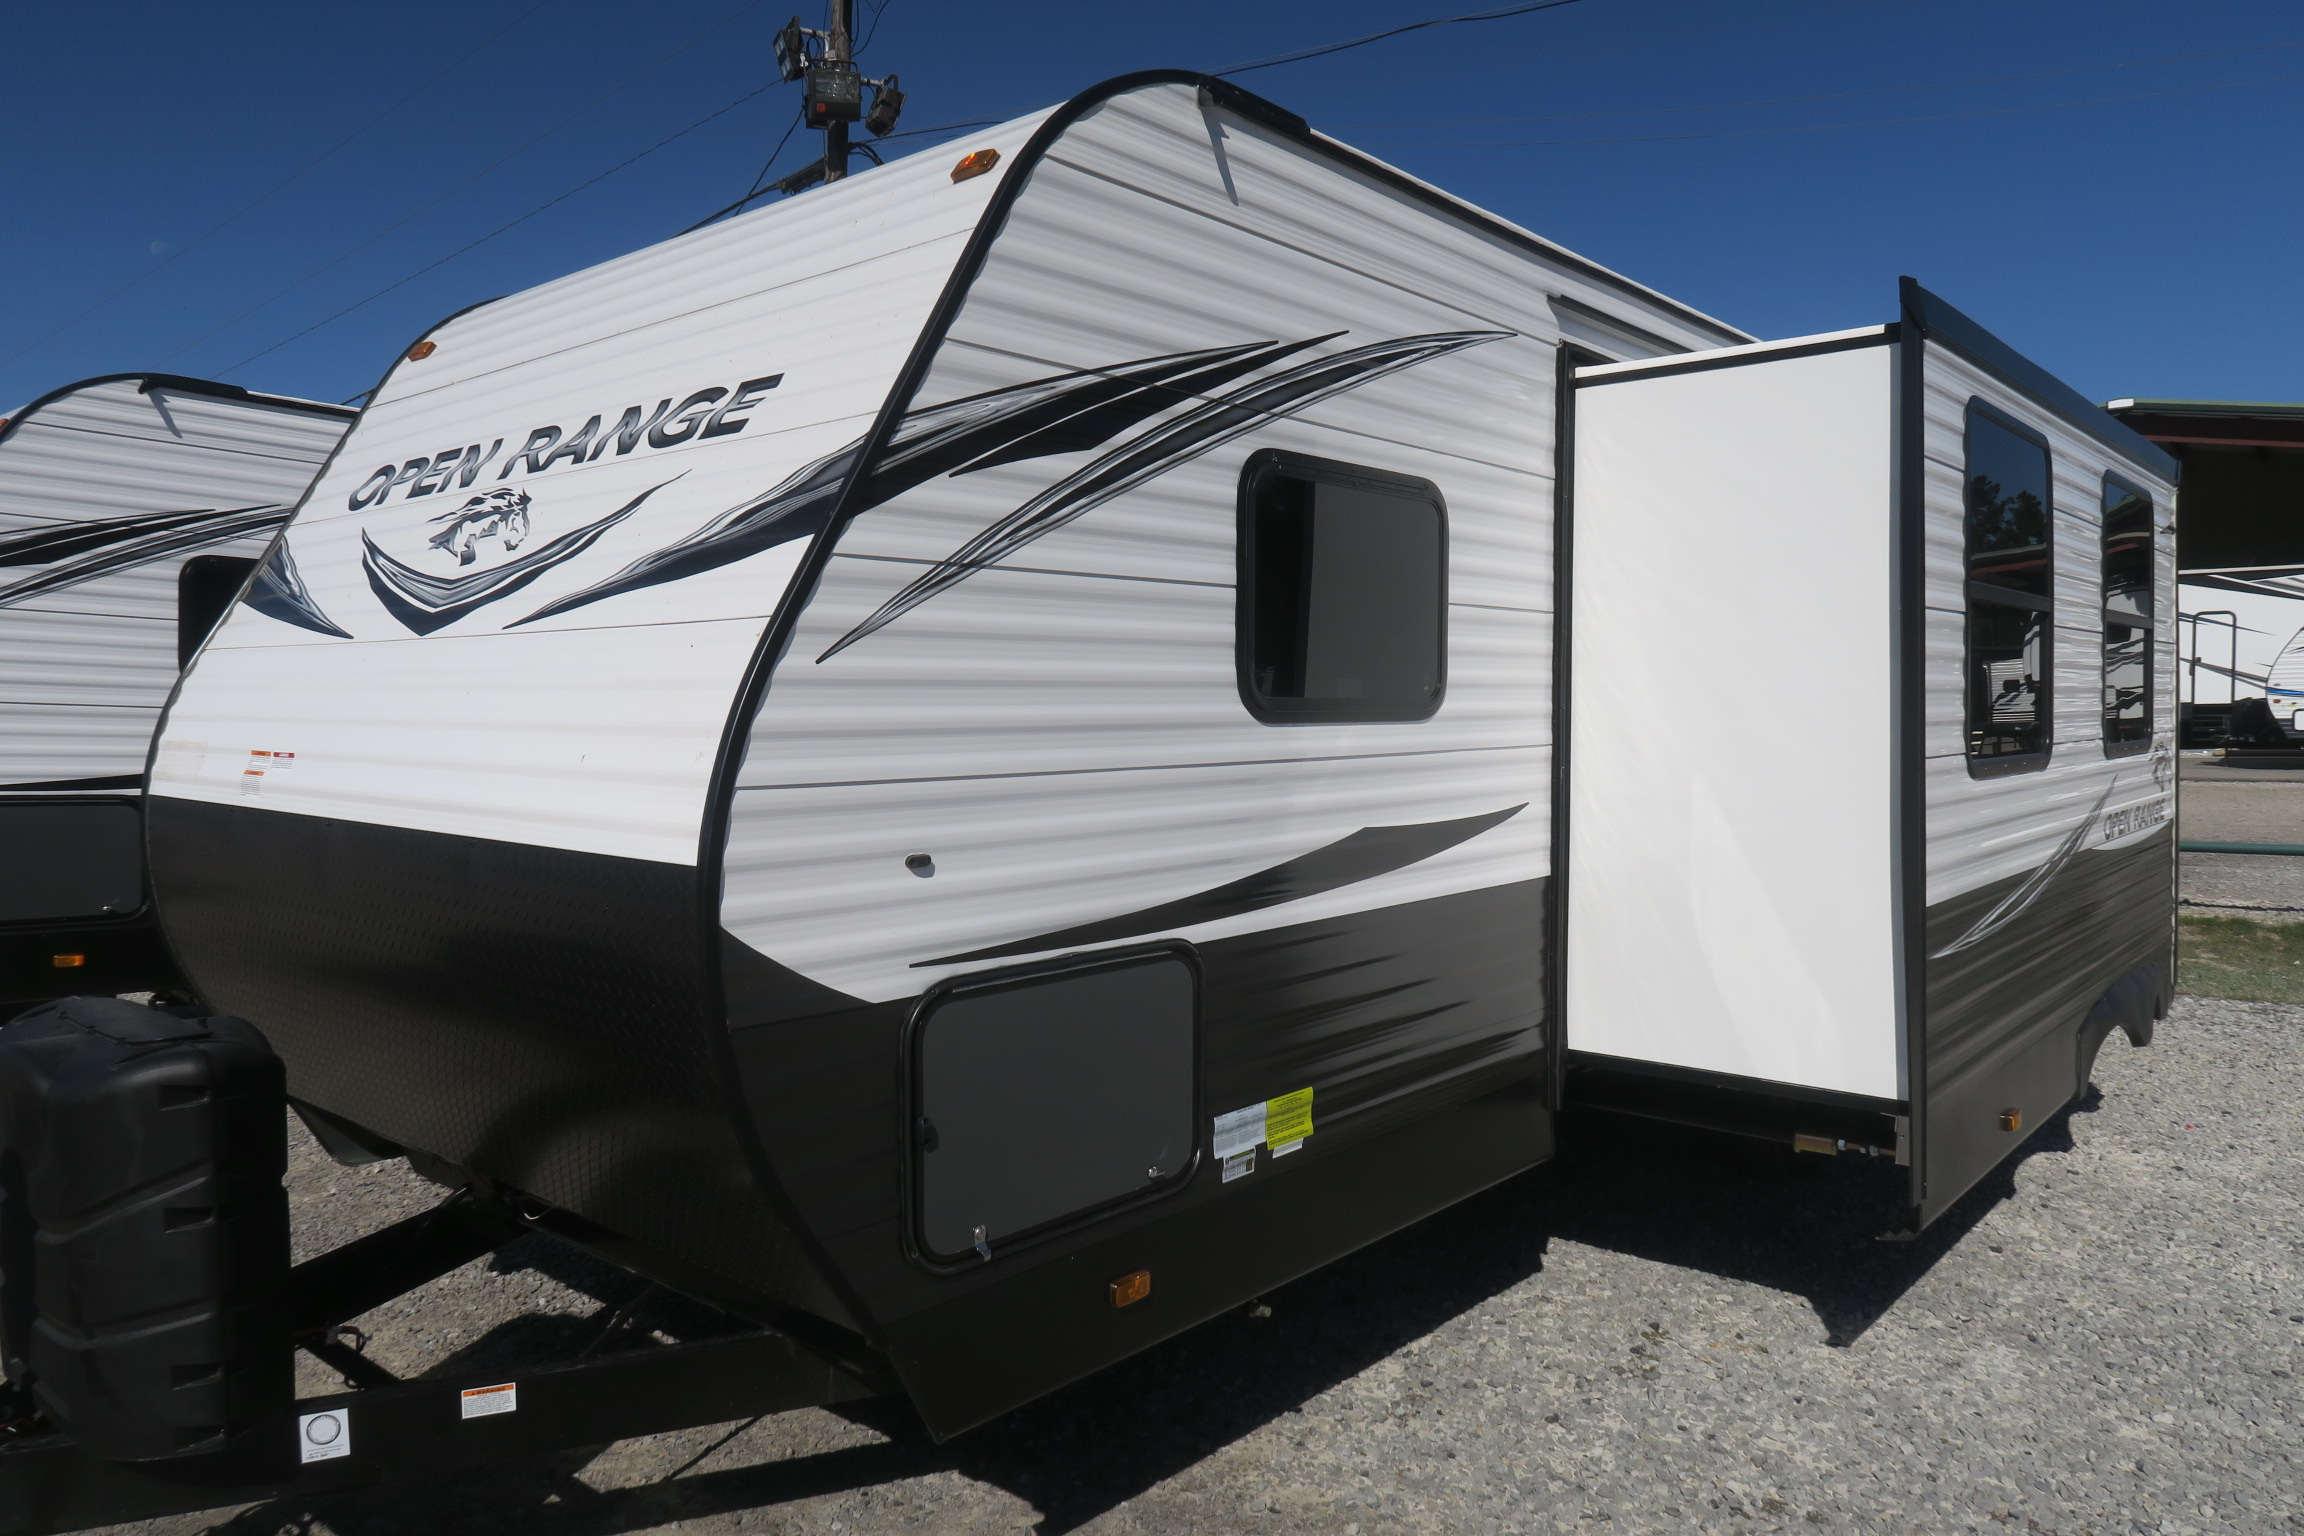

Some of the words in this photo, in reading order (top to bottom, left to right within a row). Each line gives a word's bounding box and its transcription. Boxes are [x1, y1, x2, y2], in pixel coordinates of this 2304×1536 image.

[348, 438, 504, 511] OPEN
[496, 372, 785, 480] RANGE
[2103, 807, 2133, 840] OPEN
[2133, 798, 2166, 830] RANGE
